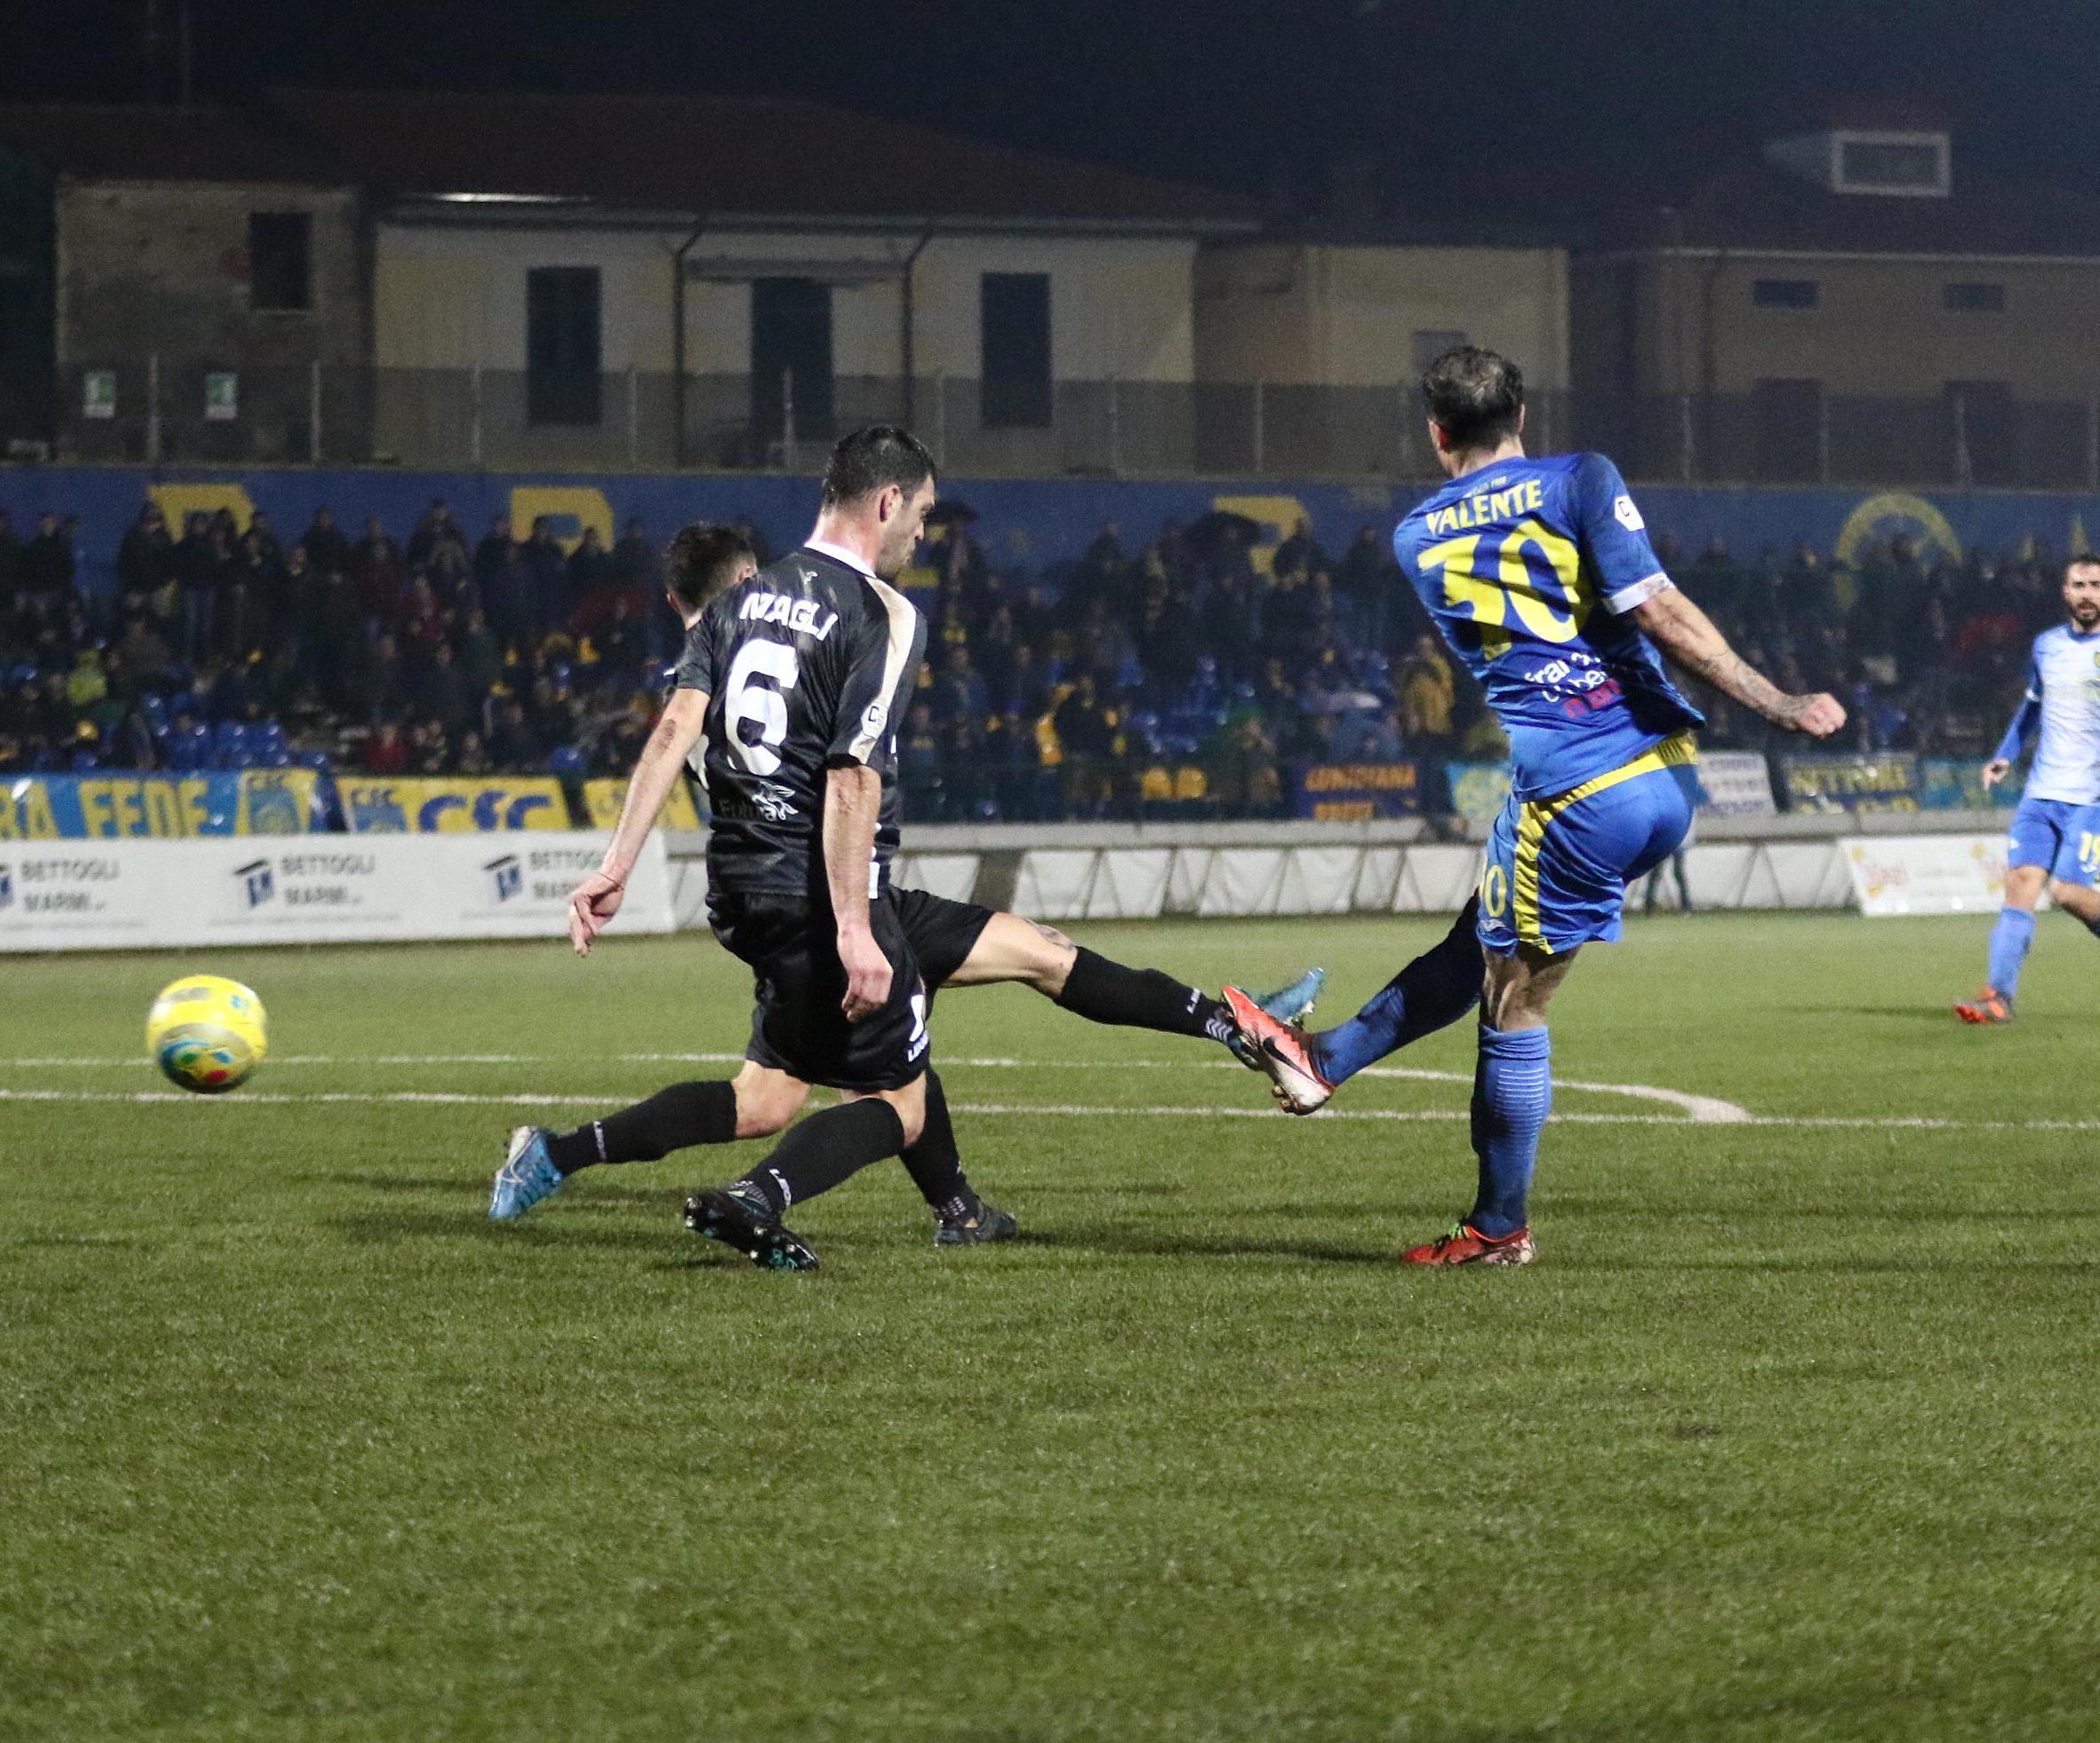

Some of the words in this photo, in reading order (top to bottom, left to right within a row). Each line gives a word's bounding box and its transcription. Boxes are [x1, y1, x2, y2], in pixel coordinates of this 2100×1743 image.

[1425, 479, 1543, 536] VALENTE
[724, 639, 800, 777] 6
[78, 780, 209, 838] FEDE
